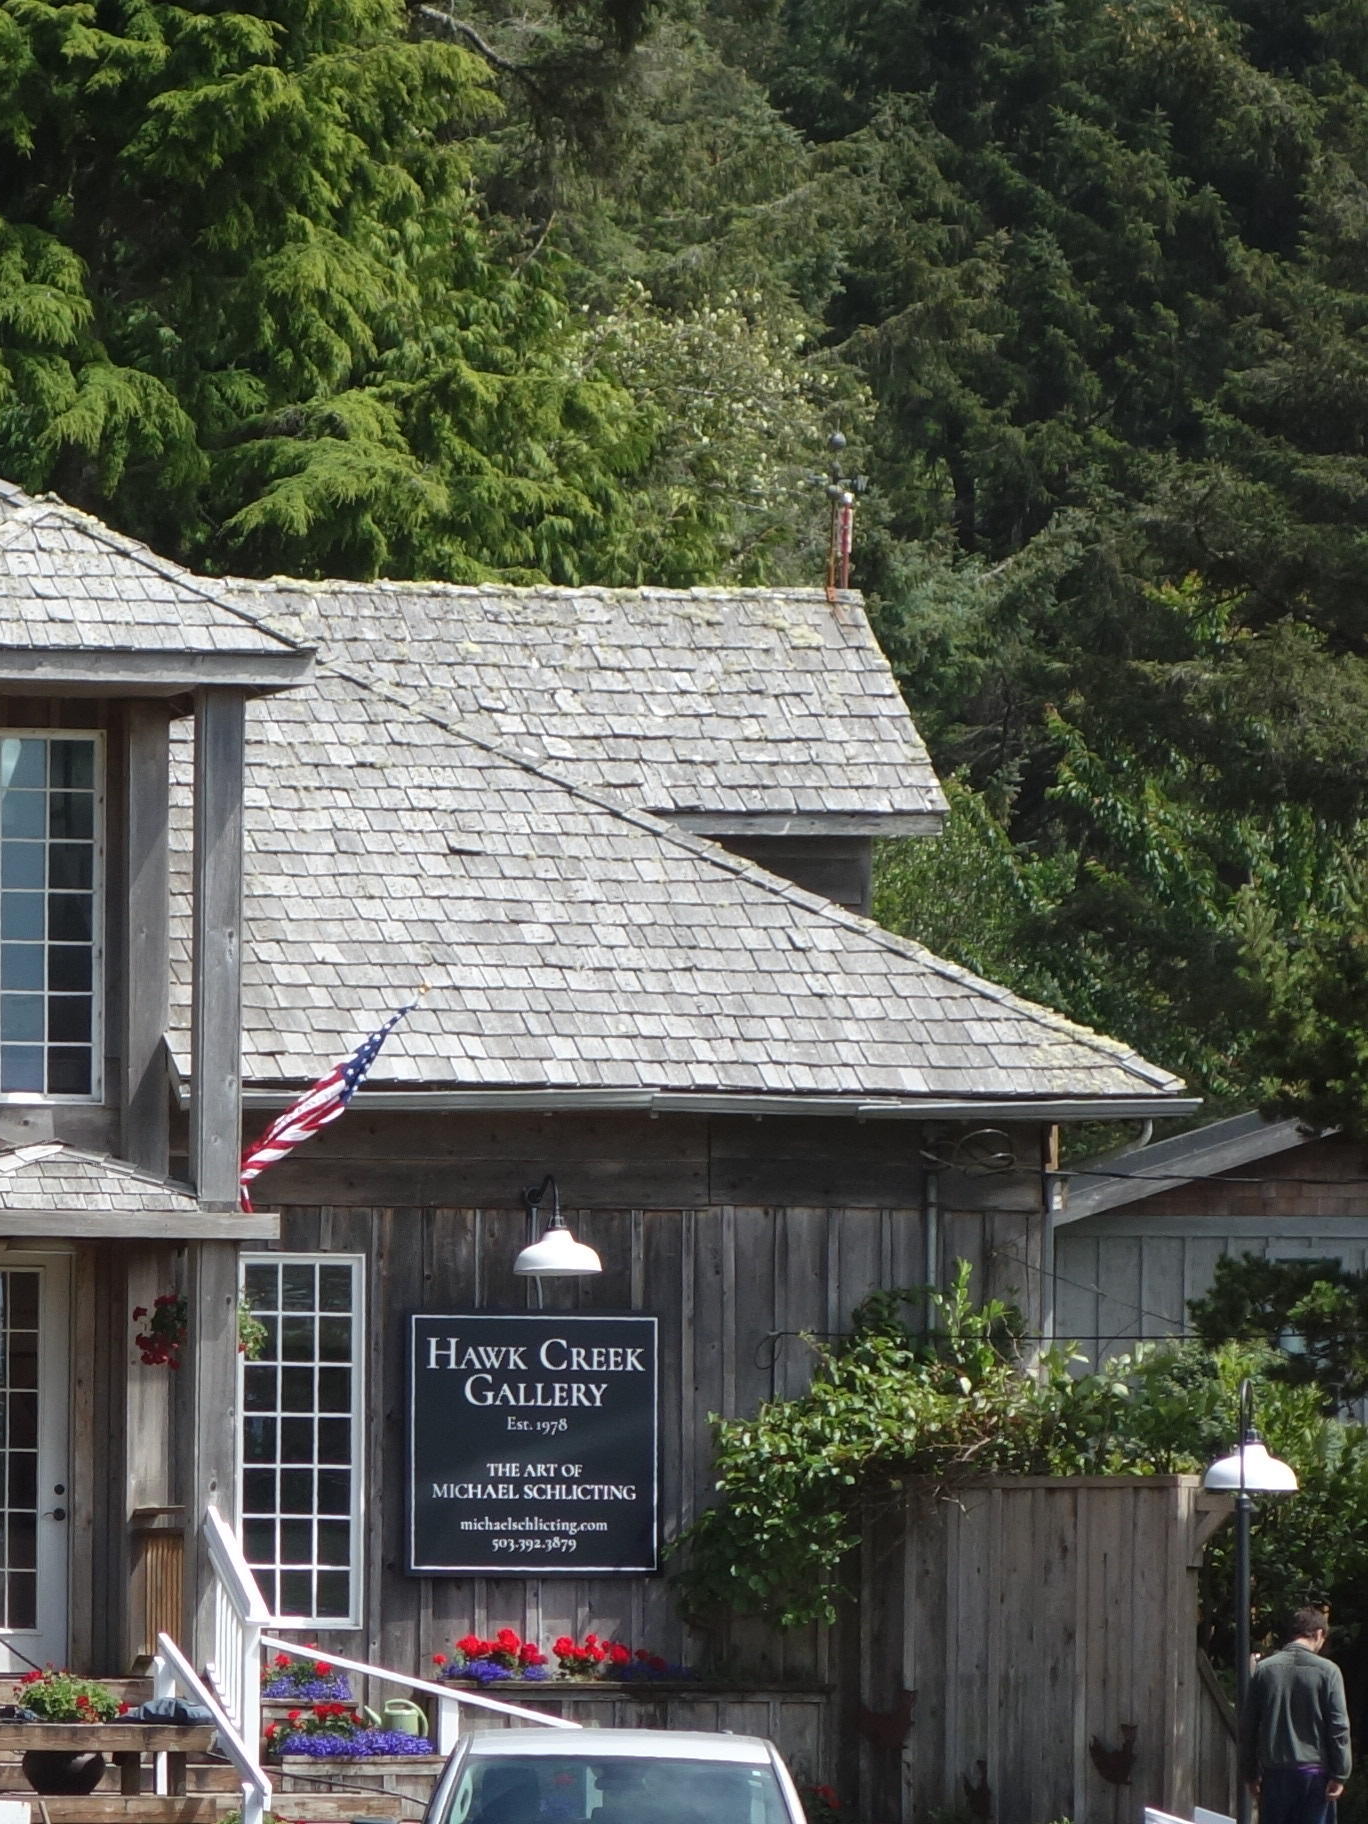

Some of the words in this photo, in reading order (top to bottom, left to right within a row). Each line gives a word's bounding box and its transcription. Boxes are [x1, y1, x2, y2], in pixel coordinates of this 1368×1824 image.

[426, 1337, 528, 1370] HAWK
[540, 1338, 646, 1372] CREEK
[464, 1373, 608, 1407] GALLERY
[507, 1416, 533, 1431] Est.
[536, 1417, 568, 1436] 1978
[486, 1463, 520, 1477] THE
[523, 1463, 558, 1478] ART
[561, 1464, 583, 1478] OF
[432, 1483, 519, 1500] MICHAEL
[523, 1484, 636, 1501] SCHLICTING
[460, 1516, 608, 1535] michaelschlicting.com
[492, 1536, 577, 1552] 503.392.3879
